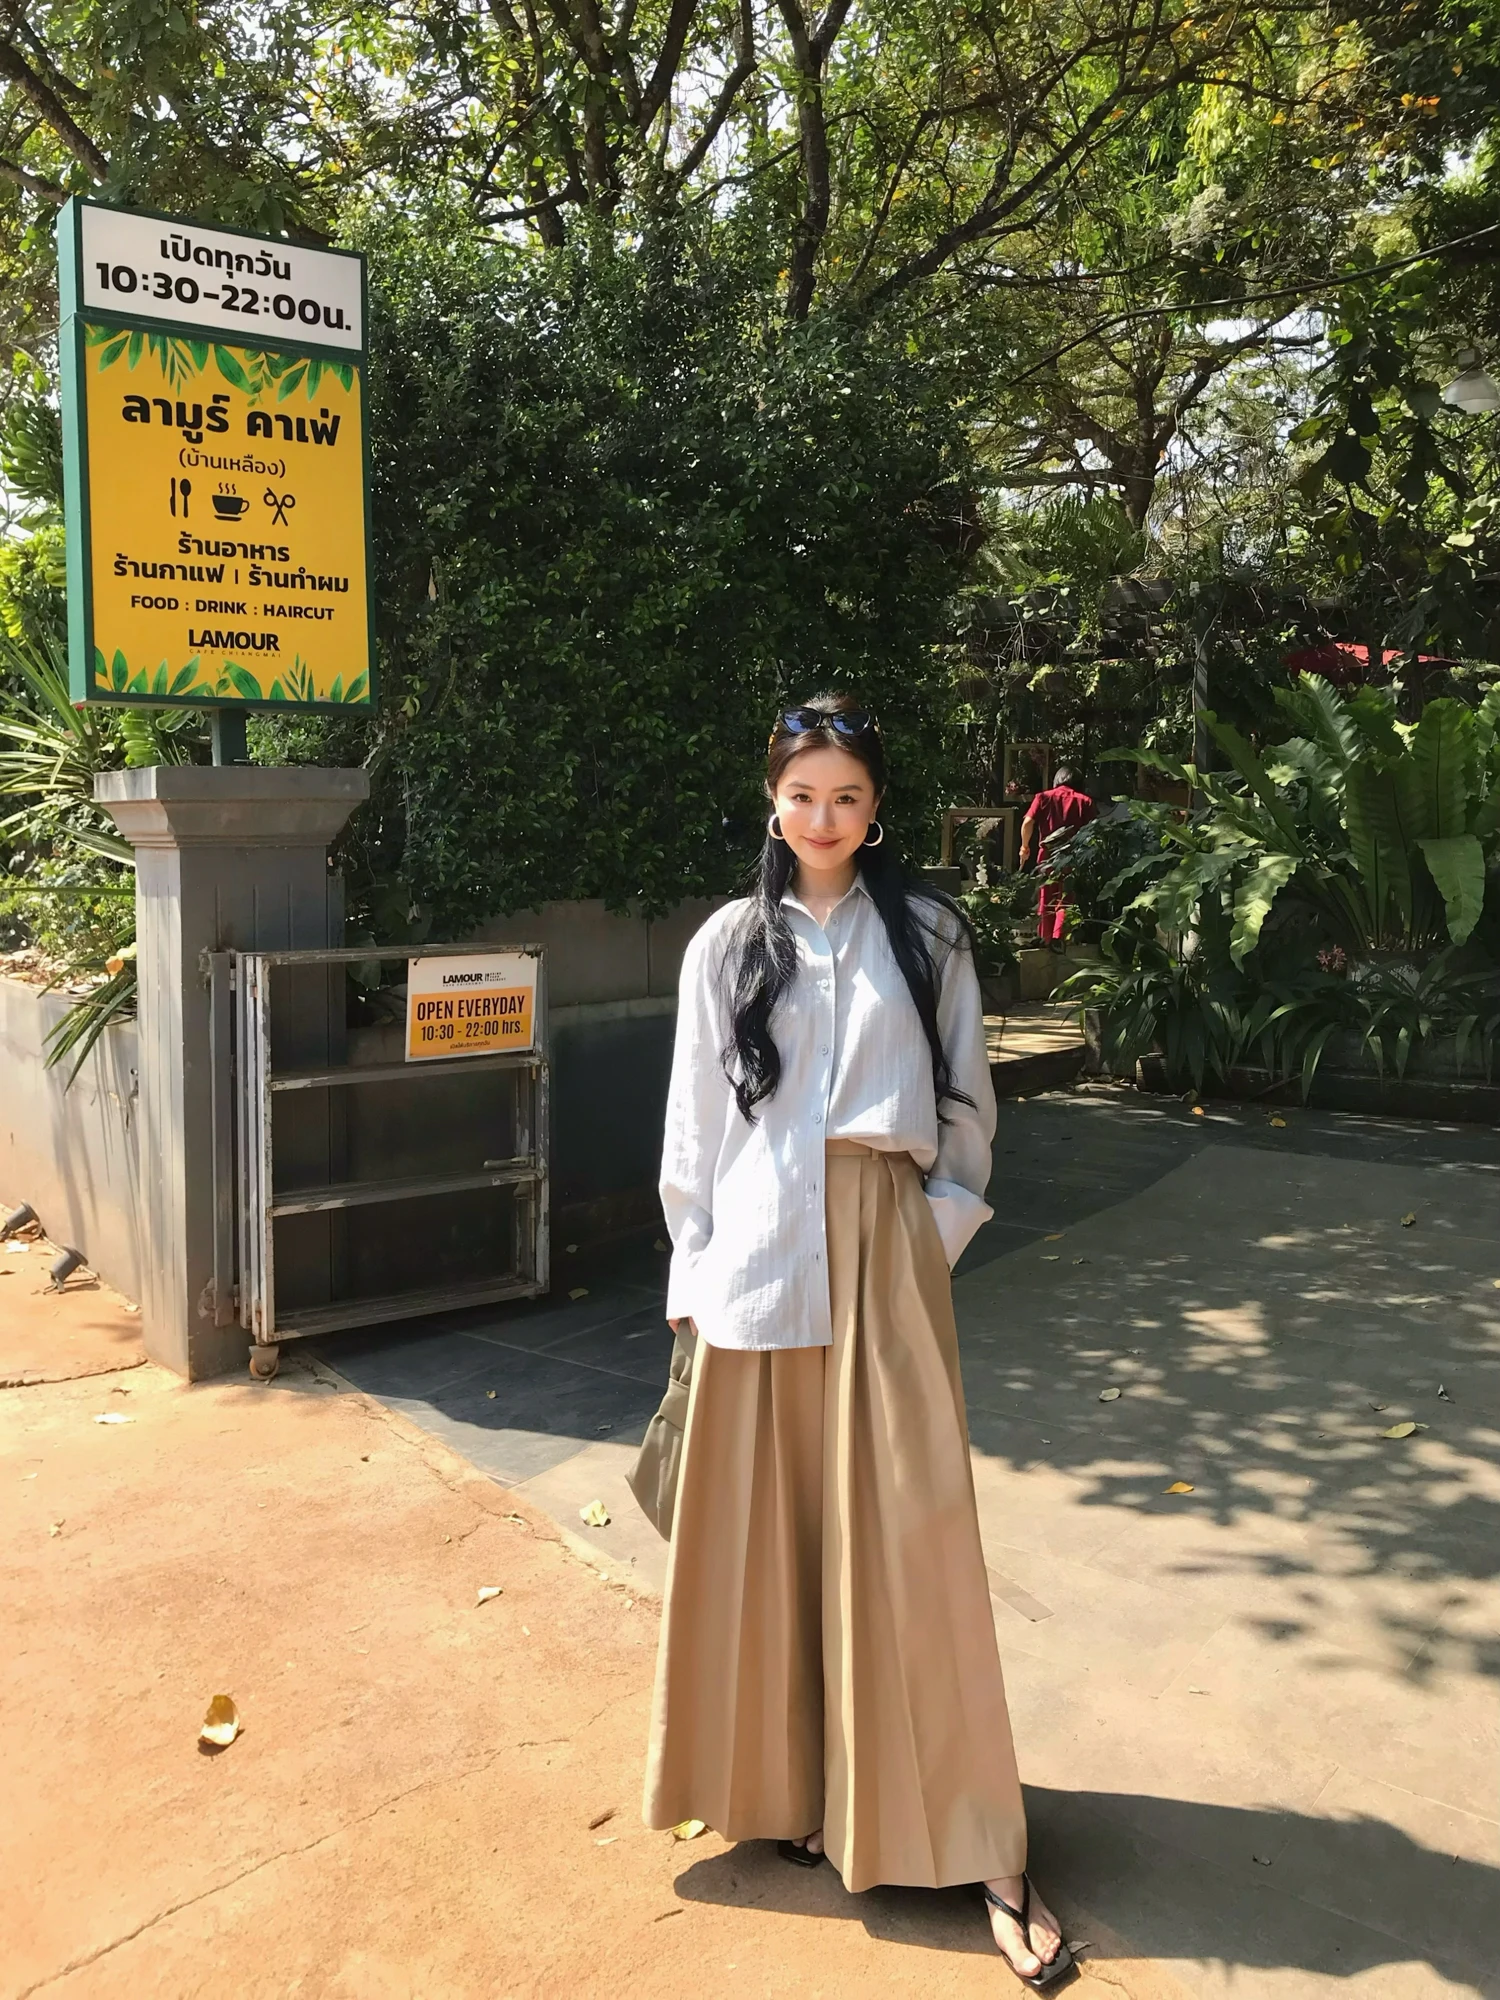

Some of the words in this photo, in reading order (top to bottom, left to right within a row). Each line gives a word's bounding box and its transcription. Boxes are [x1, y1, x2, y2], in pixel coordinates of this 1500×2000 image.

[160, 233, 291, 280] เปิดทุกวัน
[121, 394, 231, 444] ลามูร์
[246, 407, 341, 447] คาเฟ่
[179, 447, 286, 479] (บ้านเหลือง)
[178, 531, 290, 562] ร้านอาหาร
[113, 553, 225, 583] ร้านกาแฟ
[248, 564, 349, 593] ร้านทำผม
[131, 595, 179, 611] FOOD
[195, 599, 248, 615] DRINK
[263, 603, 335, 621] HAIRCUT
[188, 628, 281, 652] LAMOUR
[442, 972, 484, 985] LAMOUR
[417, 1000, 454, 1021] OPEN
[457, 995, 526, 1018] EVERYDAY
[421, 1023, 454, 1041] 10:30
[465, 1020, 499, 1038] 22:00
[502, 1019, 524, 1035] hrs.
